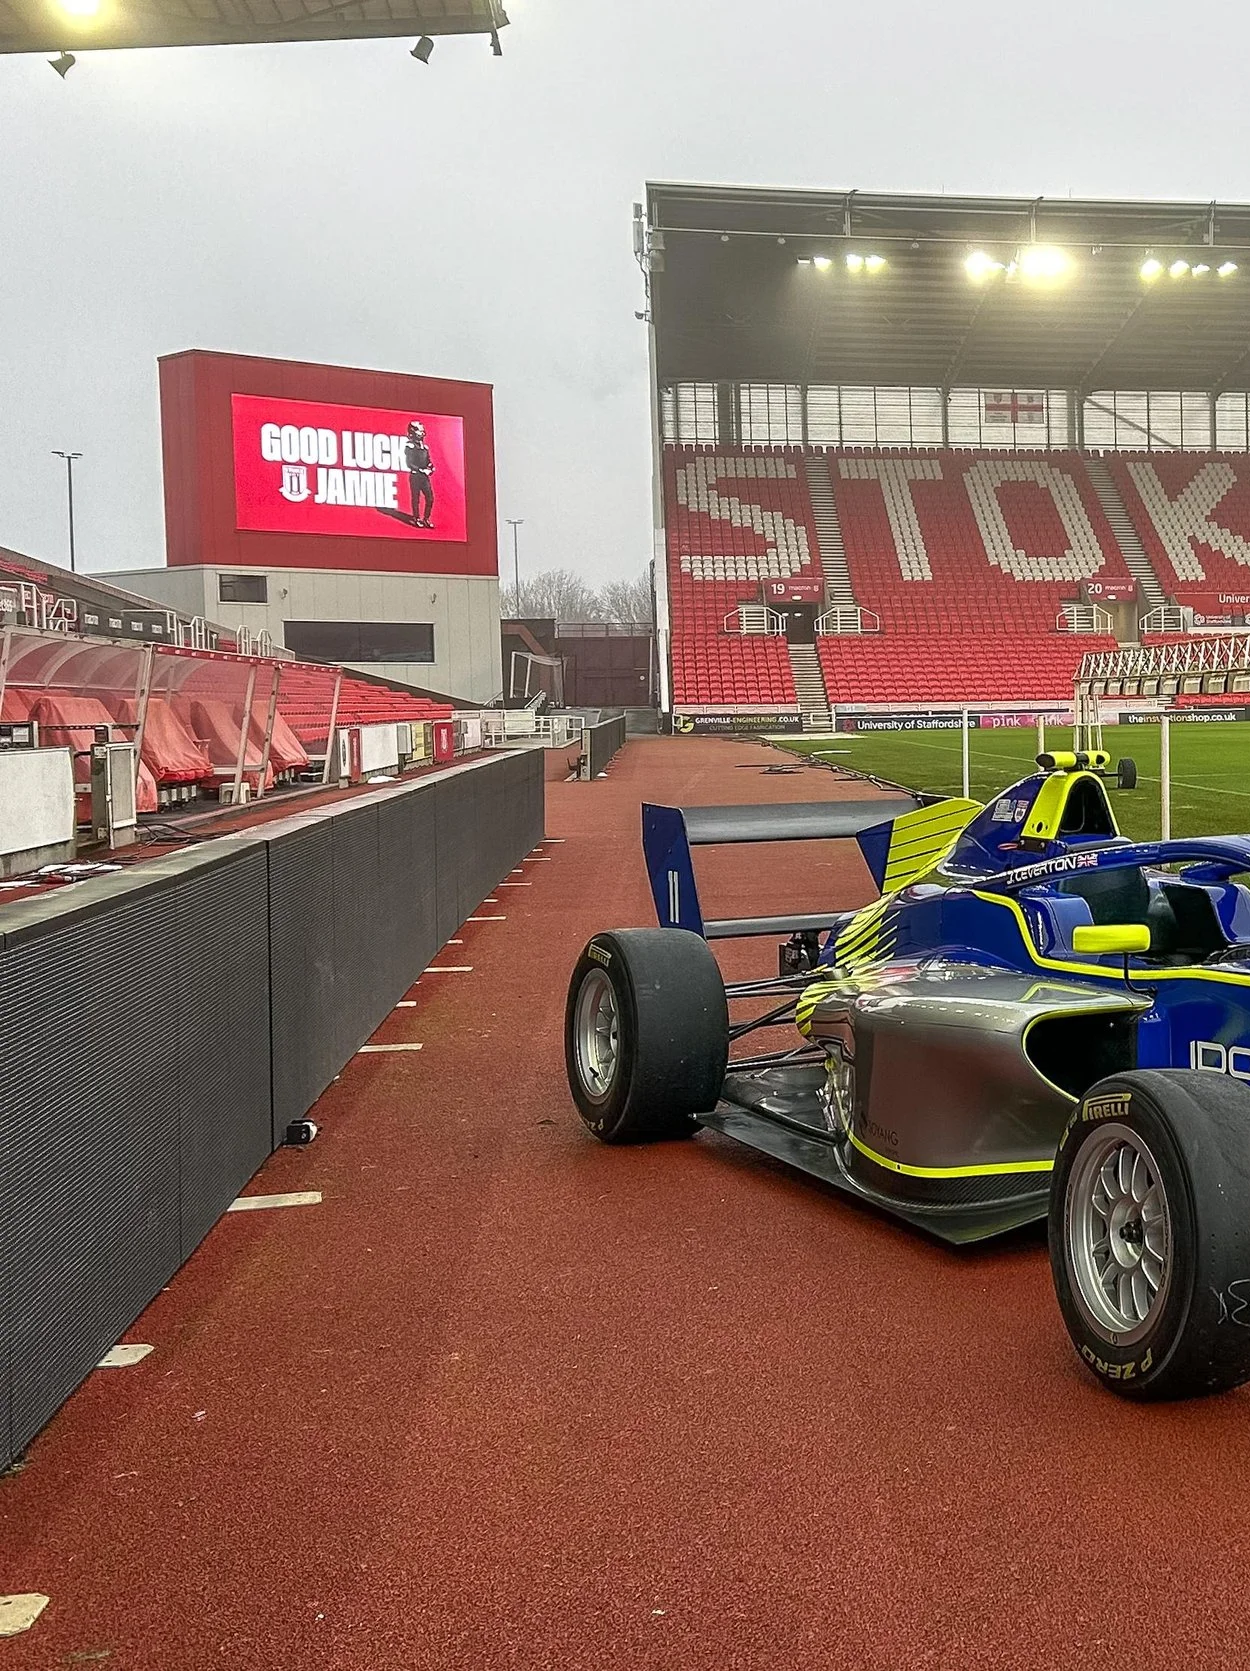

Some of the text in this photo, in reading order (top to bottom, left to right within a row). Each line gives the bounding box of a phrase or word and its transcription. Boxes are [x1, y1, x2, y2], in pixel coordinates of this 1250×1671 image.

[261, 423, 411, 473] GOOD LUCK
[314, 468, 399, 509] JAMIE
[771, 583, 785, 595] 19
[1088, 583, 1102, 594] 20
[857, 720, 903, 731] University
[904, 719, 915, 729] of
[992, 715, 1021, 728] pink
[1082, 1093, 1132, 1121] PIRELLI
[1081, 1344, 1153, 1380] P ZERO
